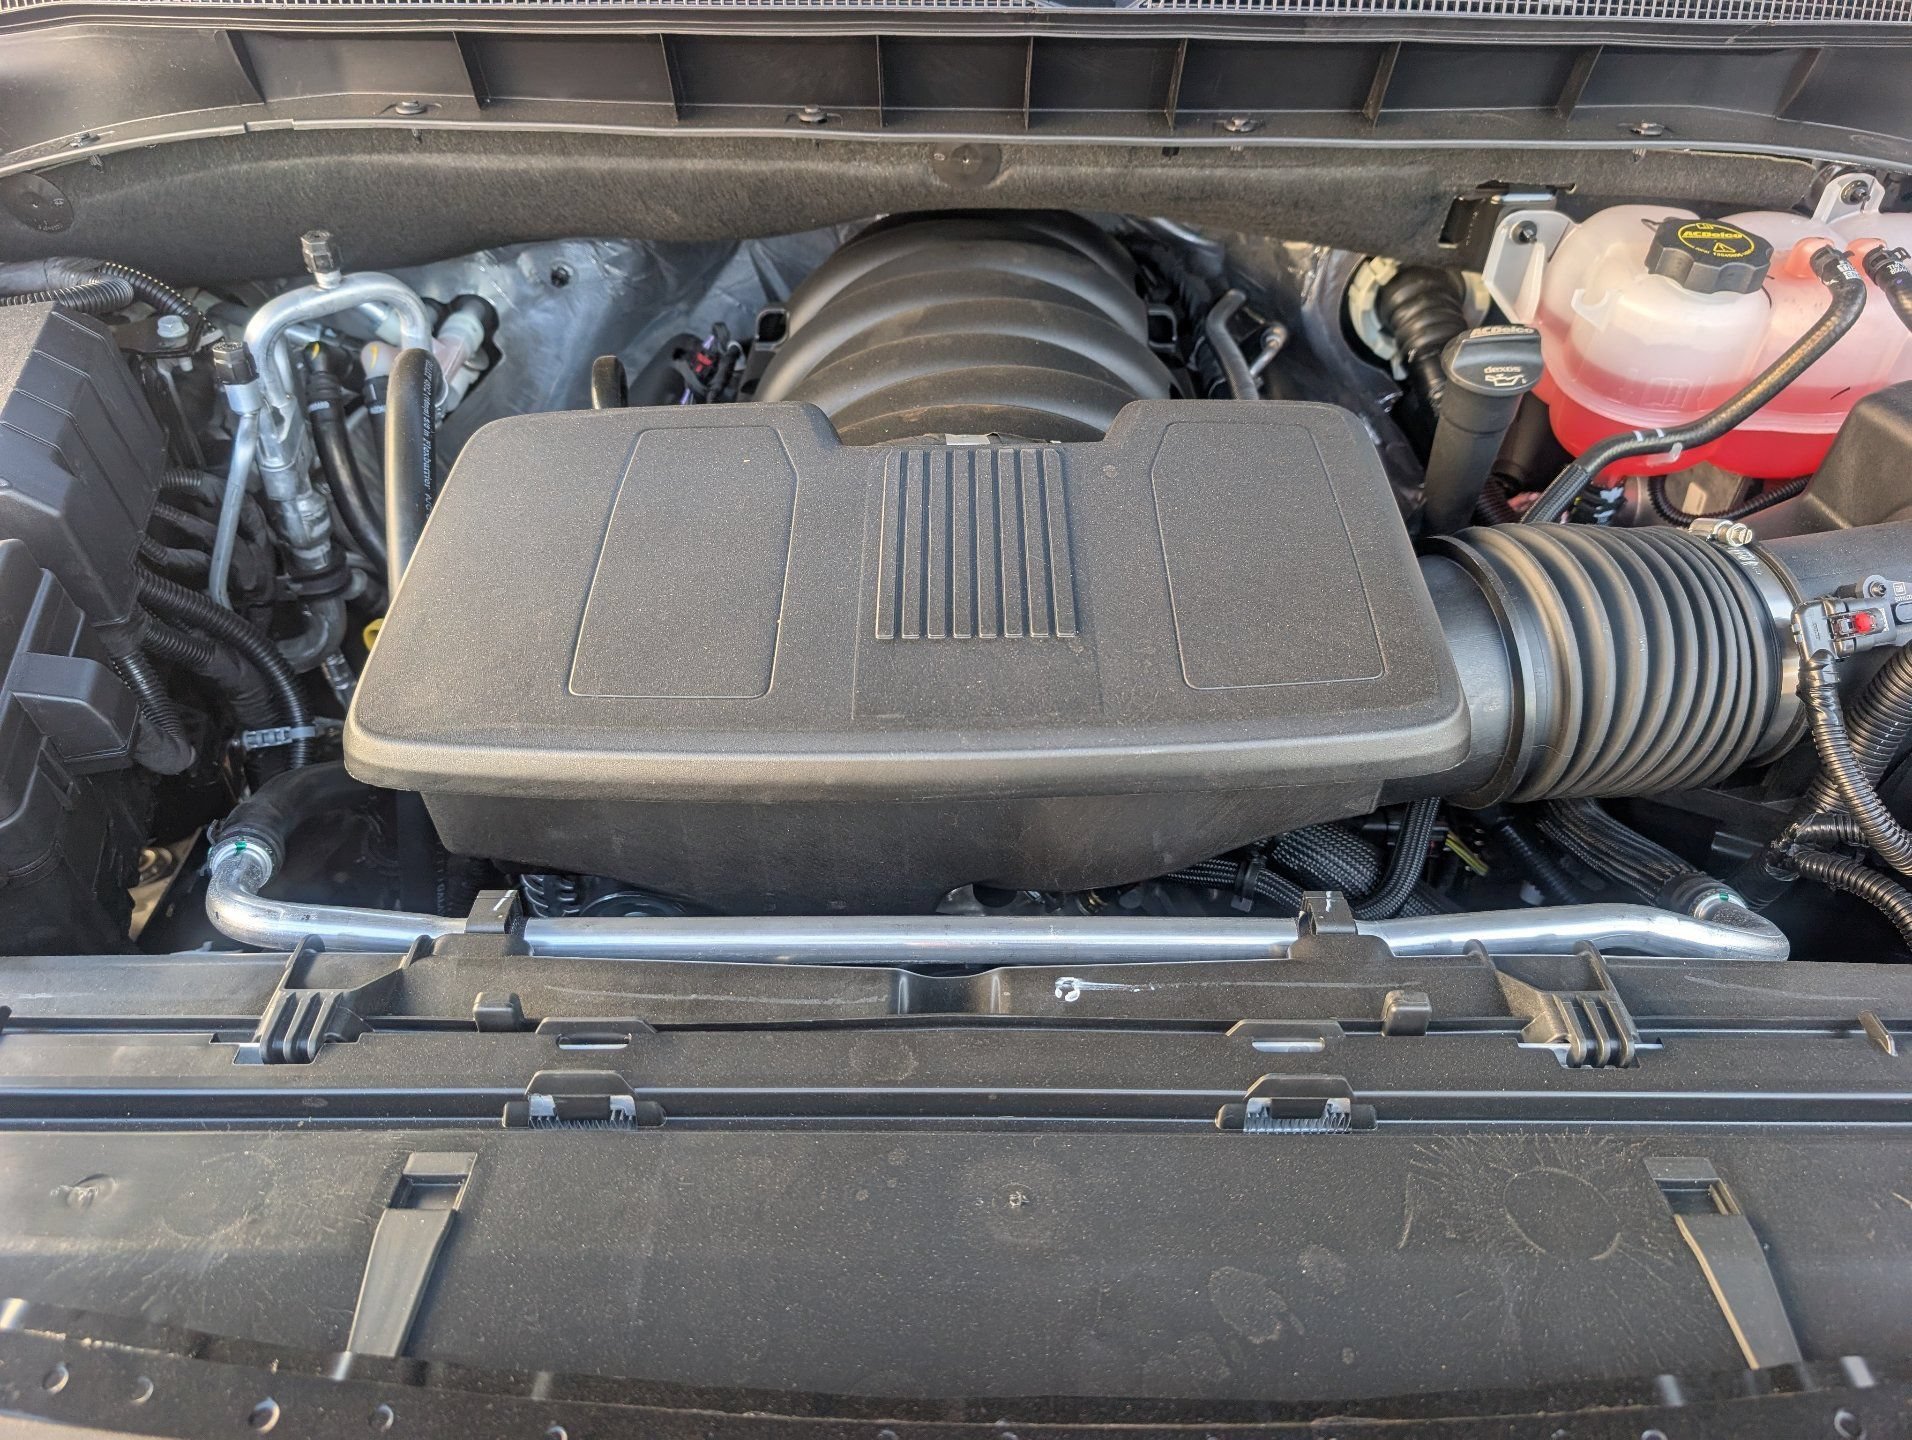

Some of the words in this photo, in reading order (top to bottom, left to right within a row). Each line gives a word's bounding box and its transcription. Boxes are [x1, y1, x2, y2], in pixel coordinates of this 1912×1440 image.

[1681, 230, 1743, 239] ACDelco
[1470, 326, 1535, 339] ACDelco
[1484, 366, 1522, 374] dexos
